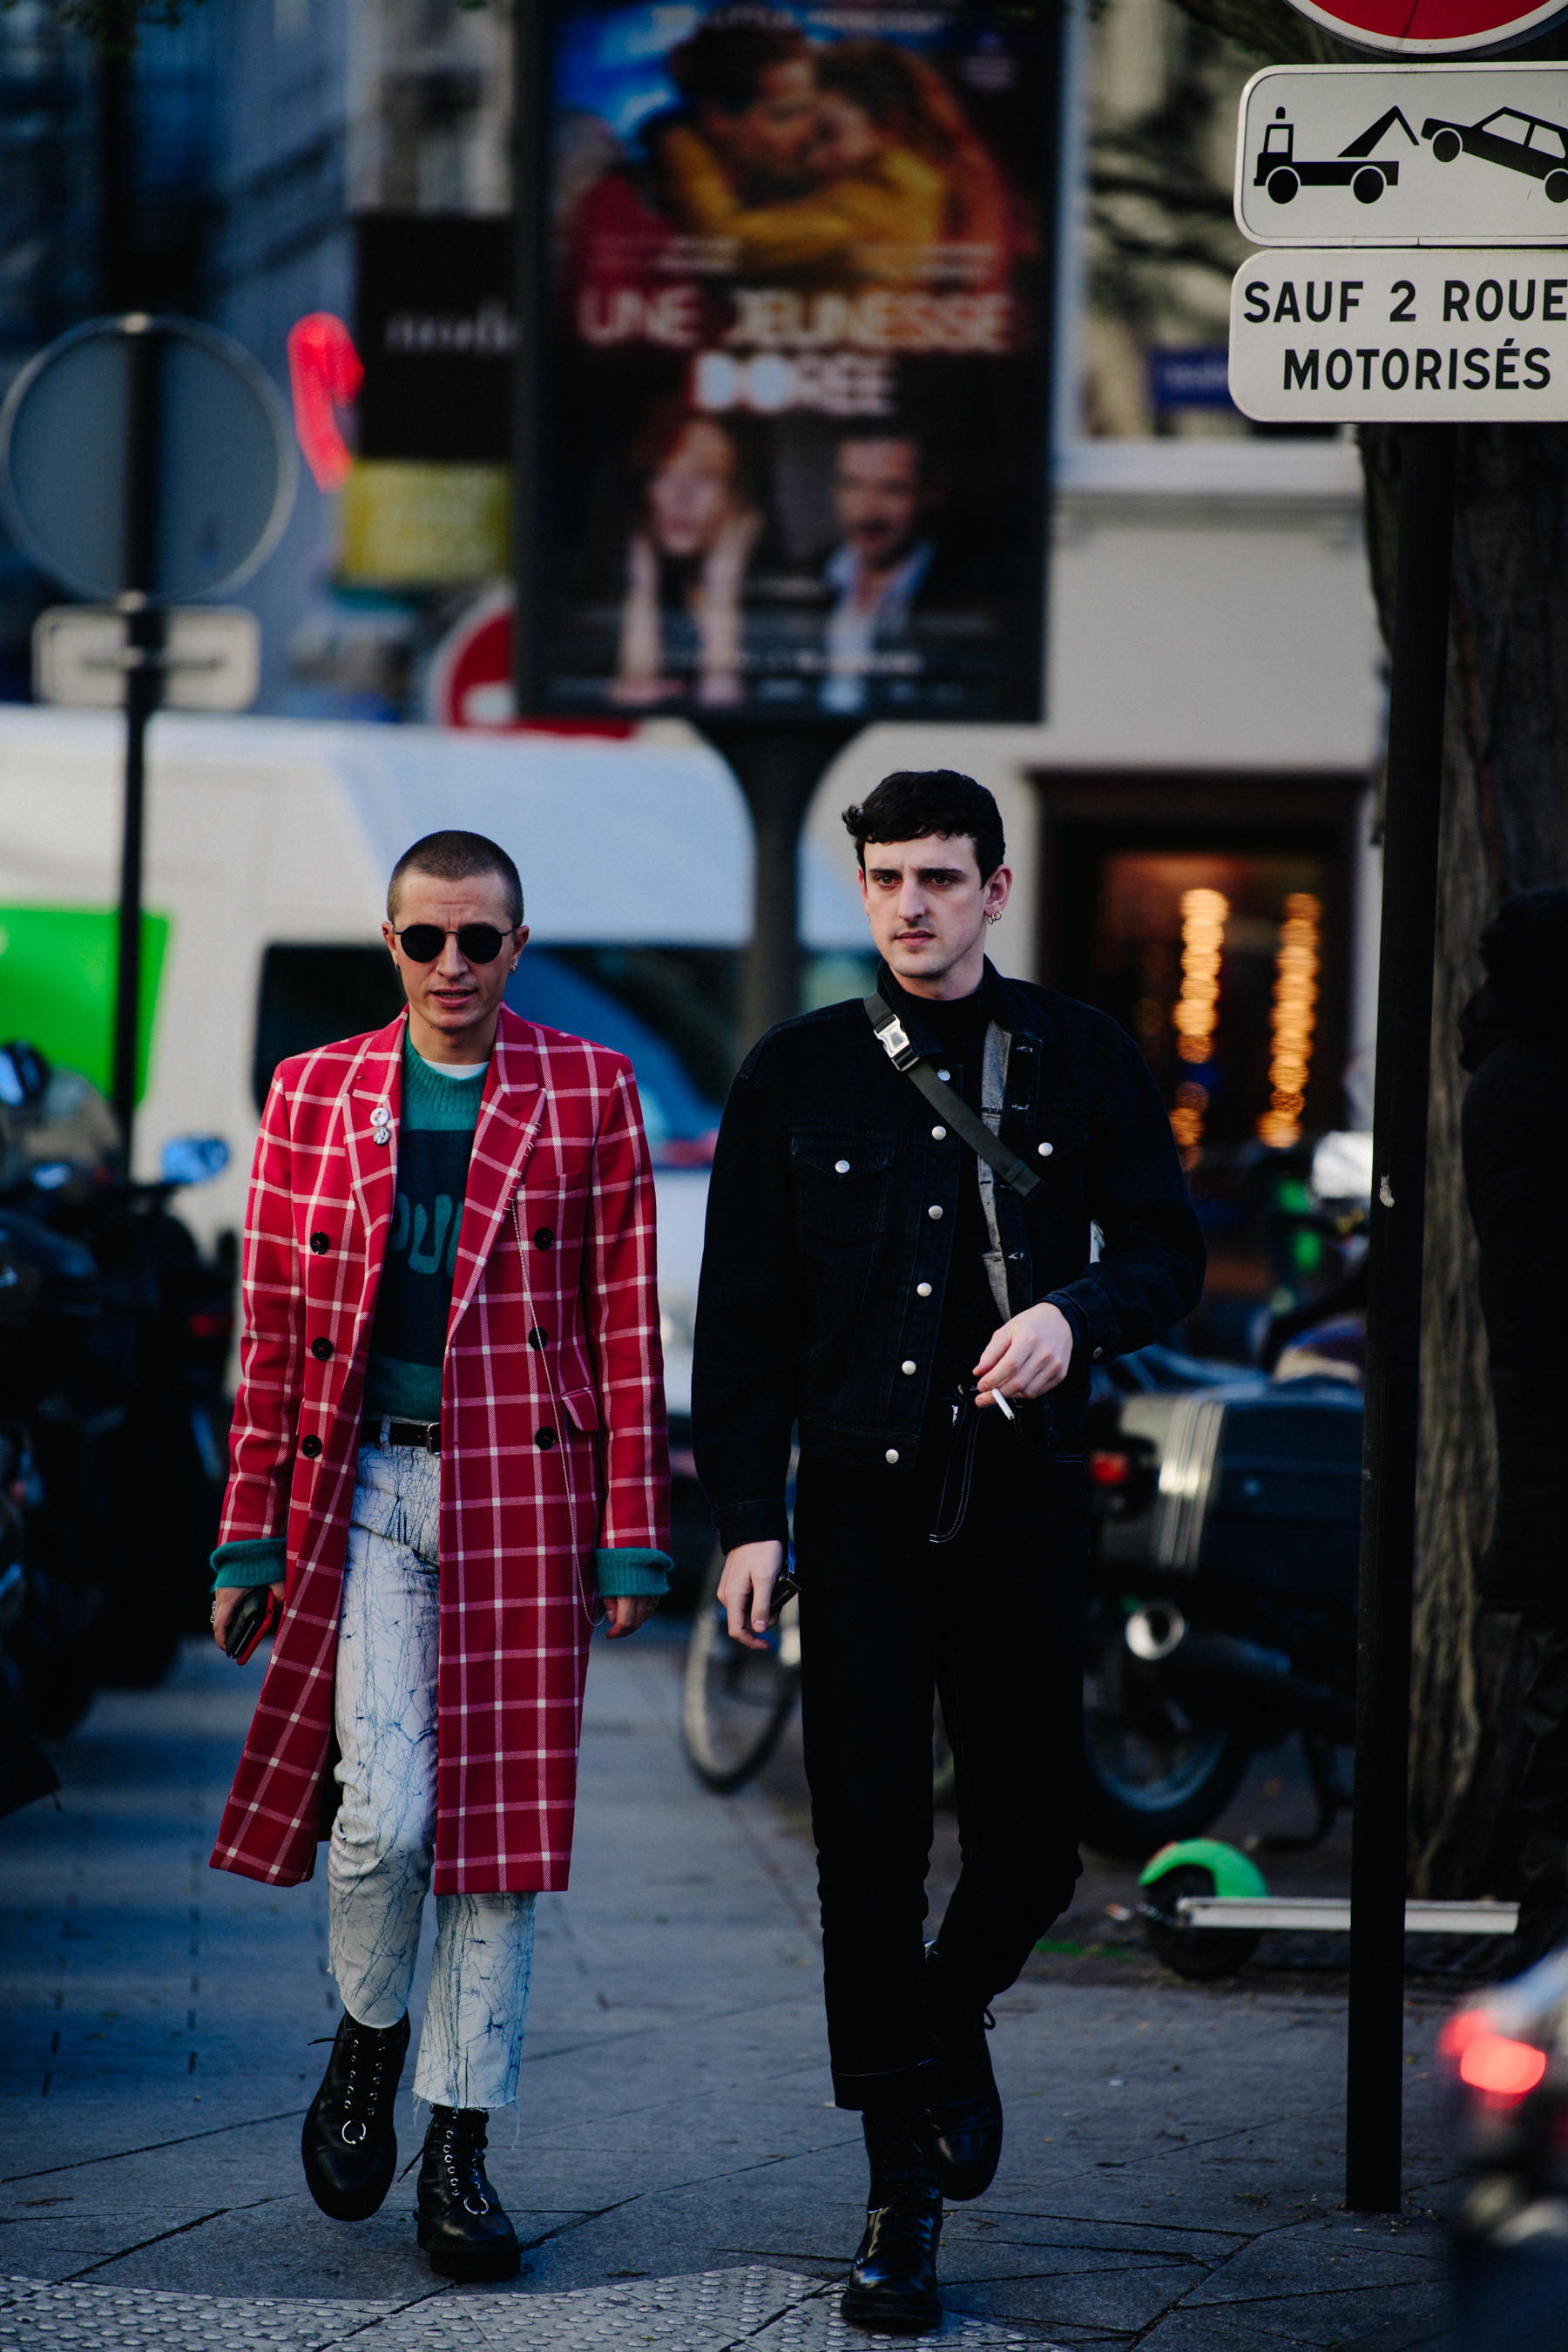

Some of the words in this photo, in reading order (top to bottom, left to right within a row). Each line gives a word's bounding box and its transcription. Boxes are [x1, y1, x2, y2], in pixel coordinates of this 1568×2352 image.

[1243, 280, 1364, 323] SAUF
[1389, 280, 1416, 322] 2
[1443, 279, 1568, 322] ROUE
[1282, 338, 1551, 391] MOTORISÉS
